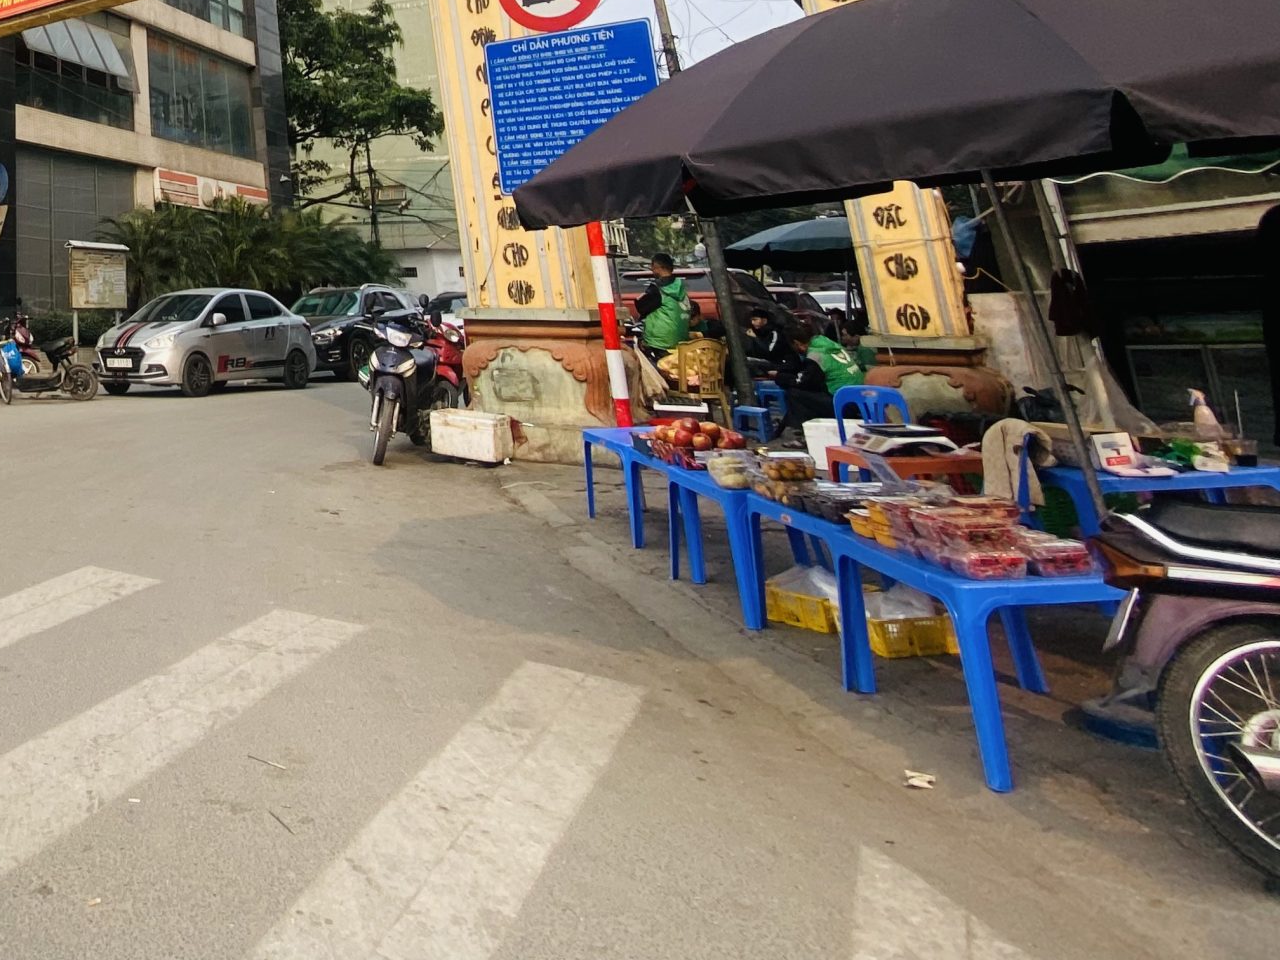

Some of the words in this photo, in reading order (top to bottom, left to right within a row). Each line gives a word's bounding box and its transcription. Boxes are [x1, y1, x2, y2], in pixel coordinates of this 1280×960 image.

[511, 42, 526, 53] CHỈ
[529, 38, 549, 50] DẪN
[550, 33, 589, 47] PHƯƠNG
[591, 29, 614, 42] TIỆN
